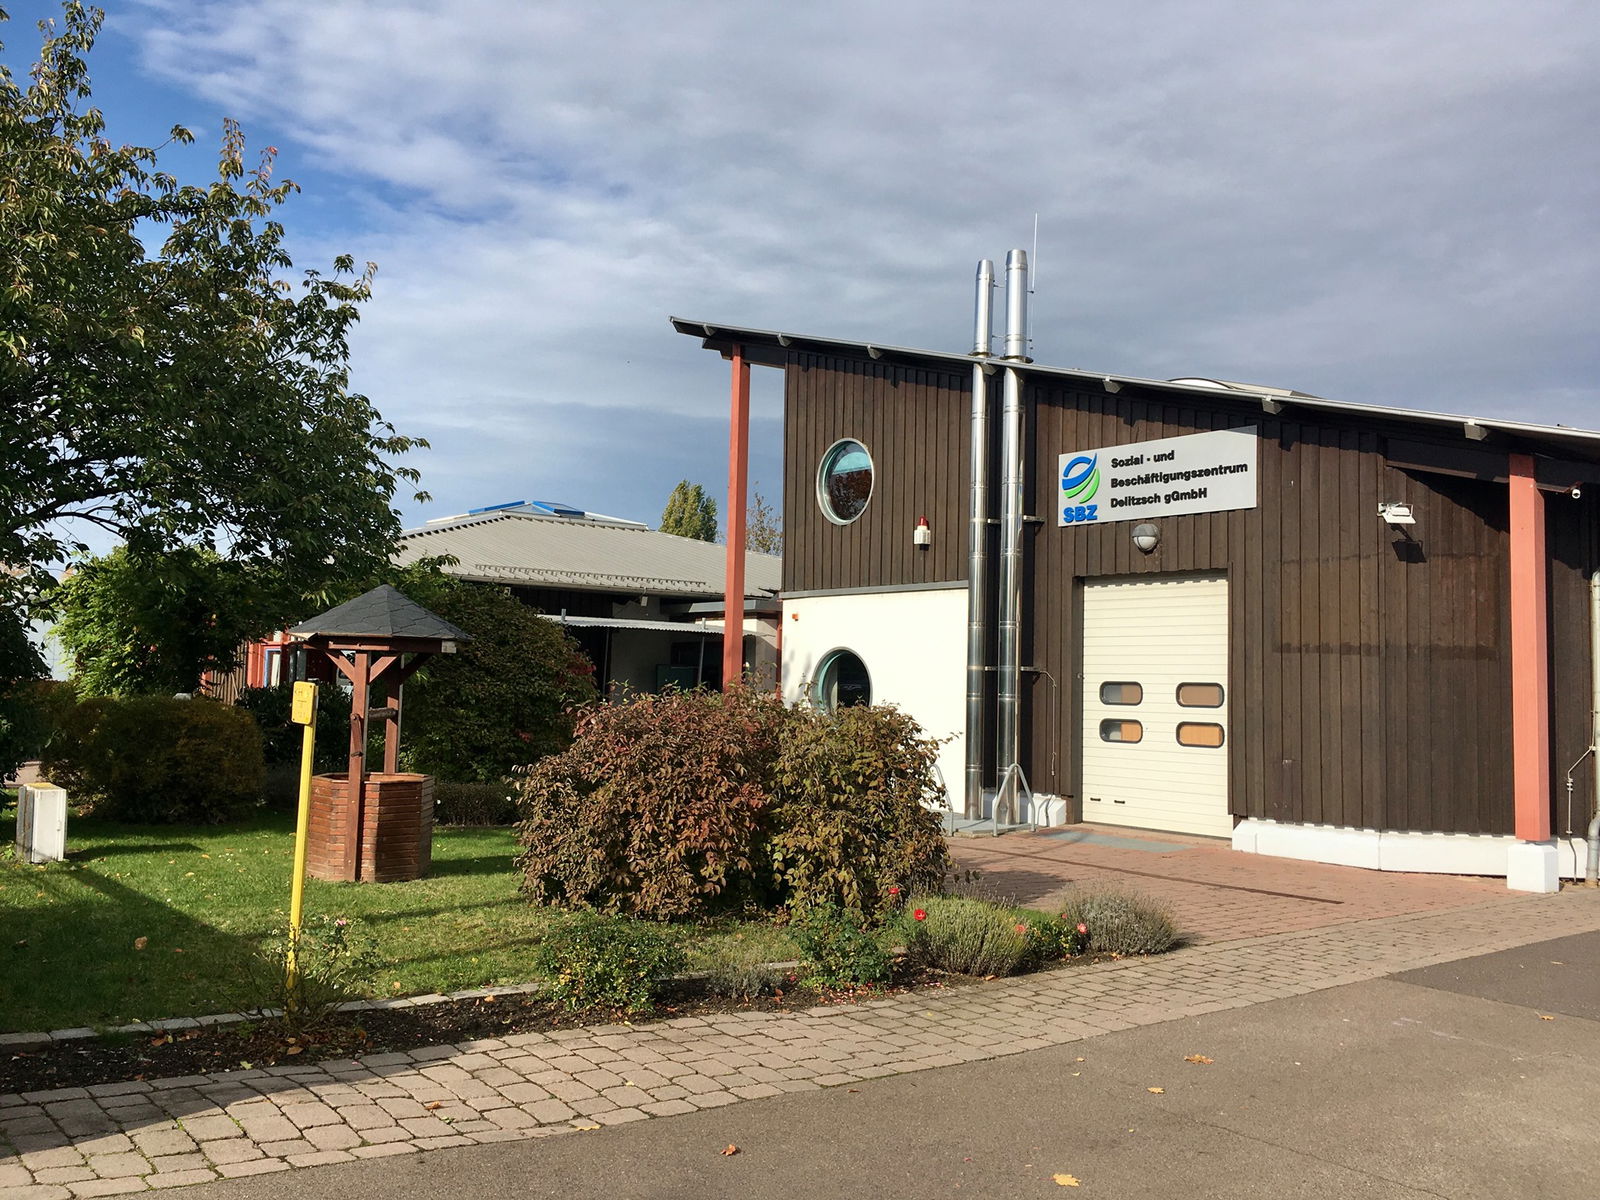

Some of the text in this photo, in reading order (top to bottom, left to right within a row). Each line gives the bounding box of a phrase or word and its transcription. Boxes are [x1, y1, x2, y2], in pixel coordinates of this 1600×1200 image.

[1111, 454, 1144, 468] Sozial
[1153, 450, 1175, 462] und
[1111, 463, 1248, 488] Beschäftigungszentrum
[1111, 487, 1207, 508] Delitzsch gGmbH
[1063, 504, 1098, 523] SBZ
